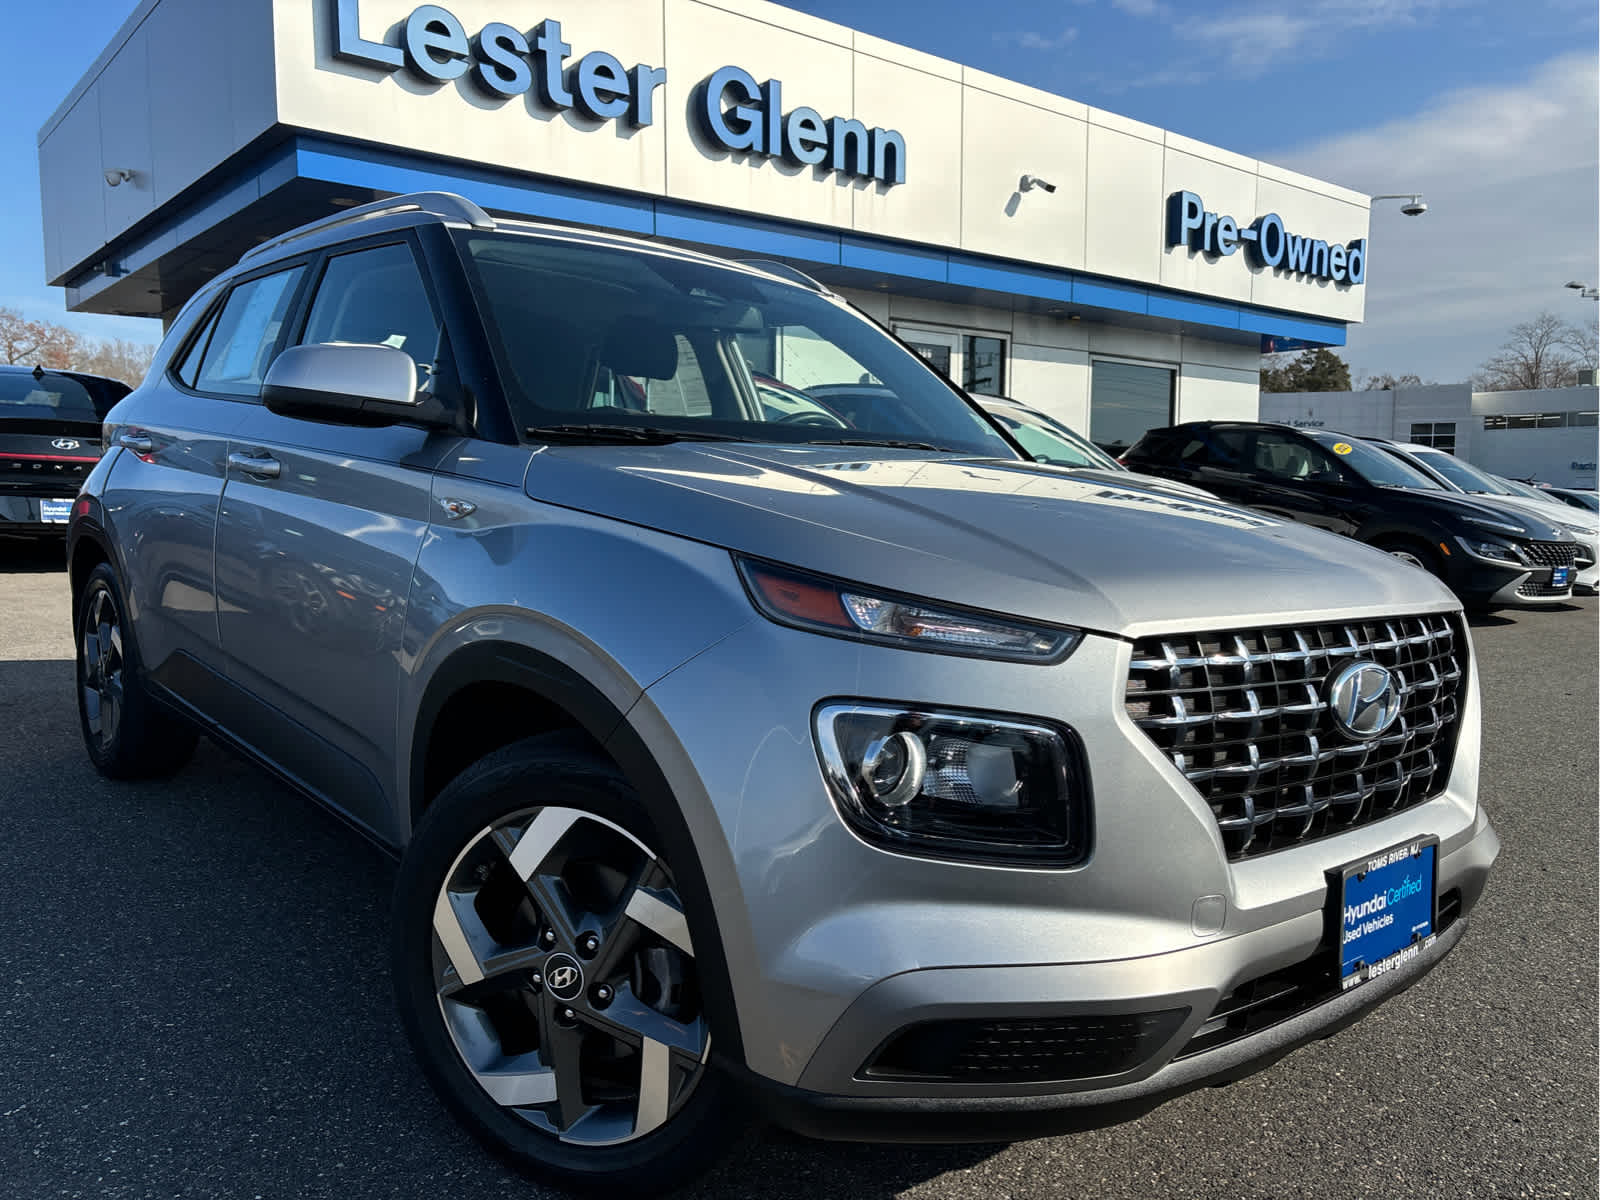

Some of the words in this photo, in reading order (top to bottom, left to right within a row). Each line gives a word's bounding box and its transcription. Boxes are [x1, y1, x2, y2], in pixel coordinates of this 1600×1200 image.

[336, 0, 667, 126] Lester
[703, 65, 906, 184] Glenn
[1178, 190, 1367, 285] Pre-Owned
[1367, 855, 1388, 872] TOMS
[1343, 890, 1387, 926] Hyundai
[1387, 874, 1422, 905] Certified
[1342, 924, 1361, 944] Used
[1362, 913, 1394, 935] Vehicles
[1368, 945, 1419, 980] lesterglenn
